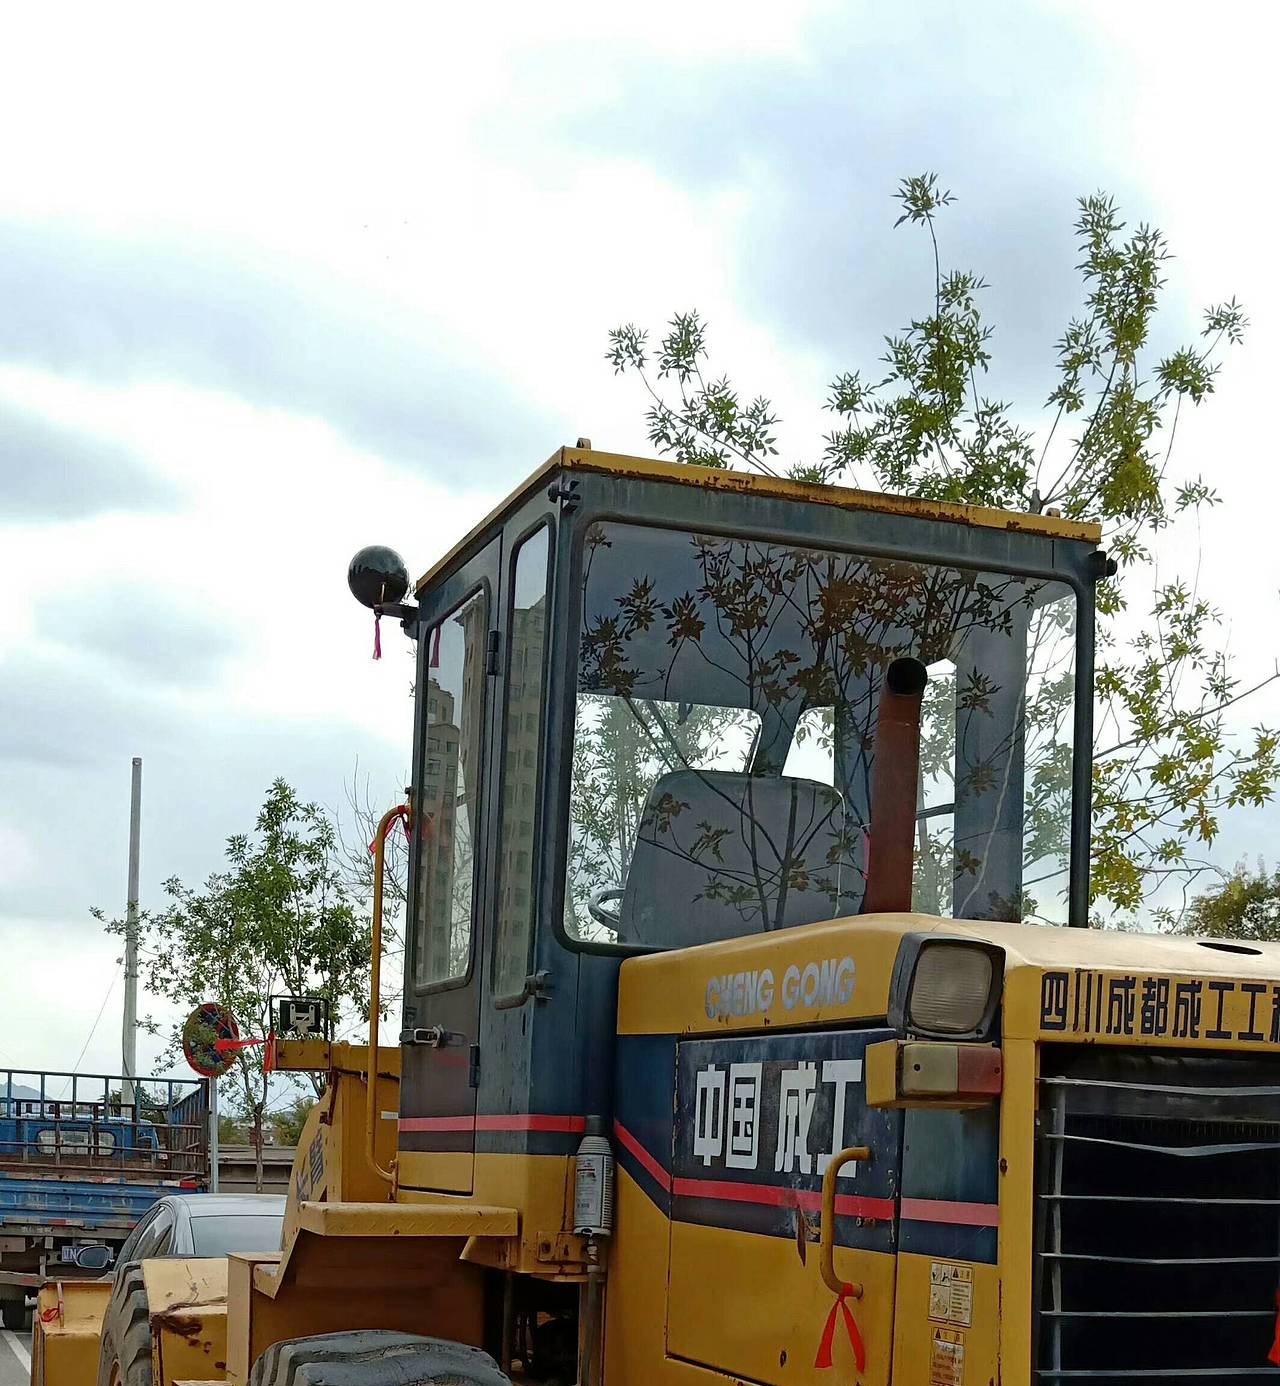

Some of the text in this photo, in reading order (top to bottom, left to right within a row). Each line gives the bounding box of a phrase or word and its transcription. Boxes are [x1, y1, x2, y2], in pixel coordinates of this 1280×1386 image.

[705, 956, 857, 1019] CHENG GONG
[693, 1059, 863, 1179] 中国 成工
